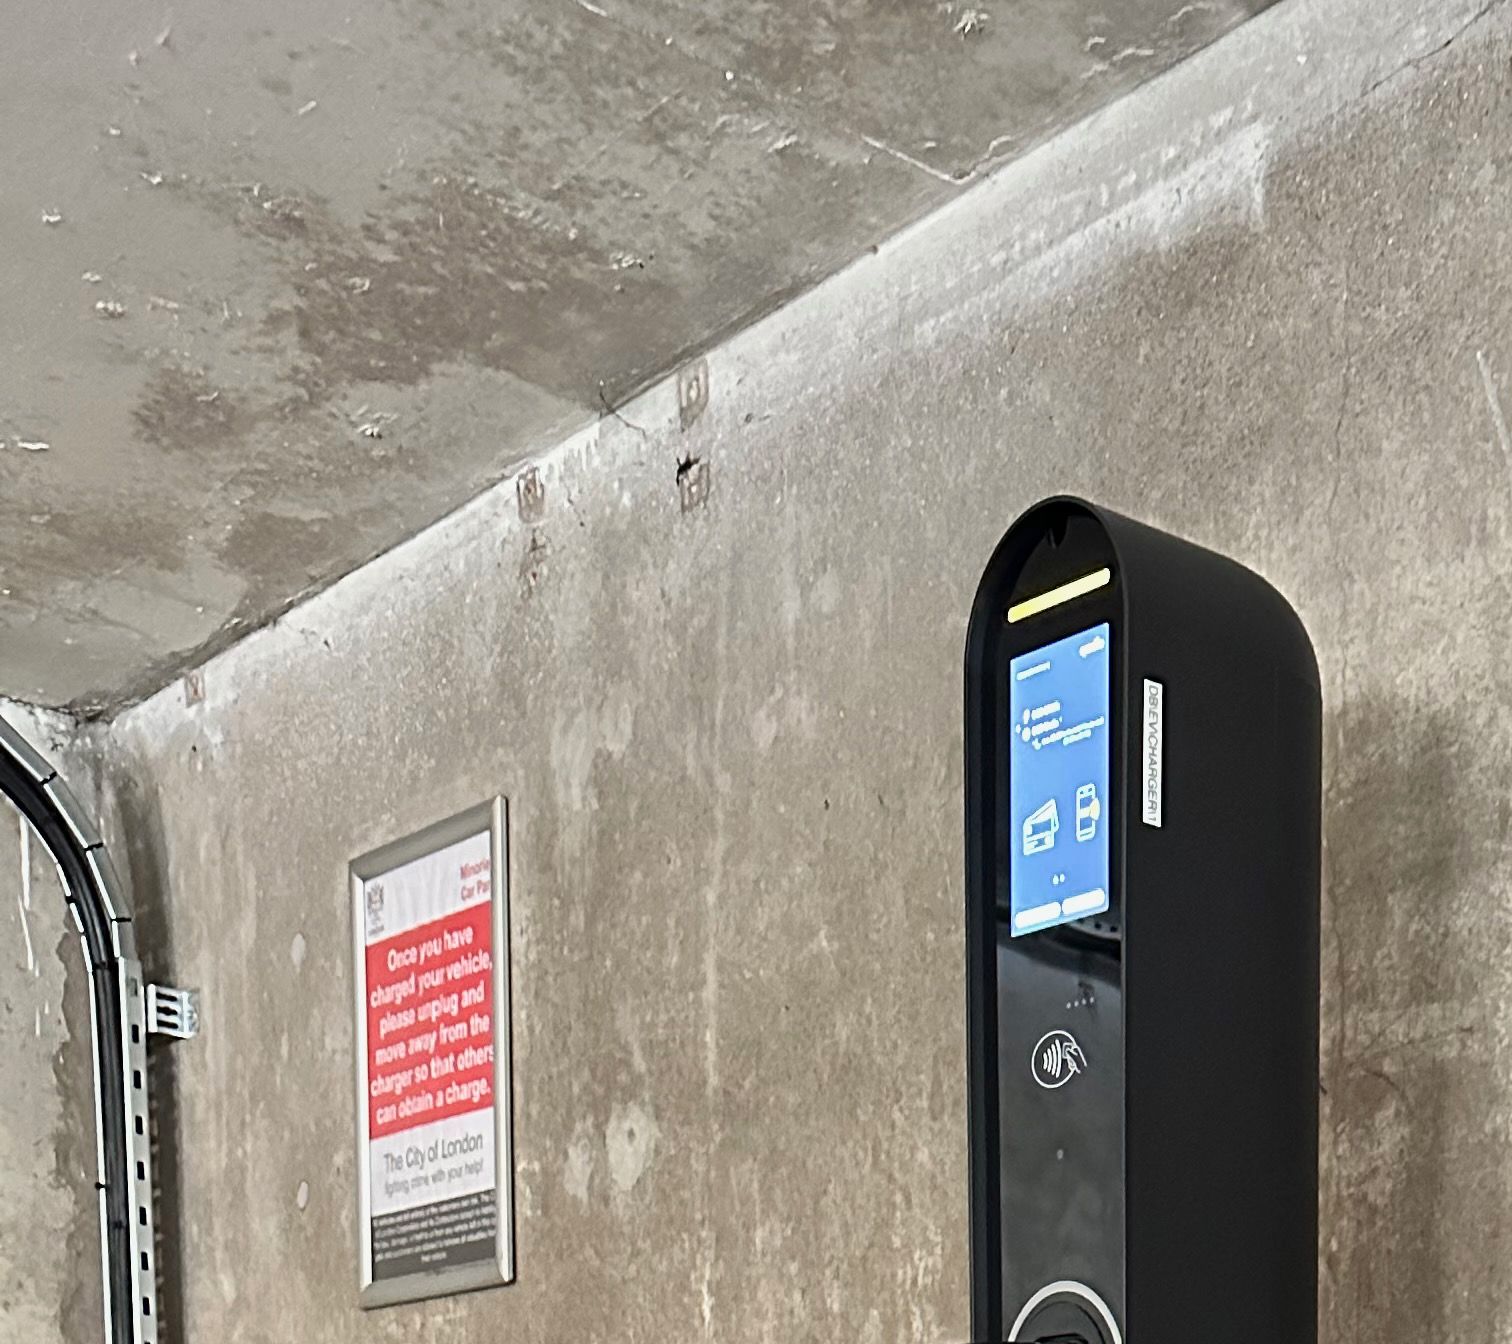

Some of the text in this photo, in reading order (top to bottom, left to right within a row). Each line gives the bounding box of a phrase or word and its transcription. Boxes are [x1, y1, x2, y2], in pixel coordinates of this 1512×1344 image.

[388, 926, 473, 972] Once you have
[370, 972, 415, 1007] charged
[418, 968, 446, 996] your
[379, 981, 485, 1039] please unplug and
[375, 1012, 490, 1065] move away from the
[370, 1067, 413, 1096] charger
[414, 1063, 428, 1083] so
[430, 1053, 455, 1079] that
[376, 1078, 491, 1125] can obtain a charge.
[384, 1132, 483, 1173] The City of London
